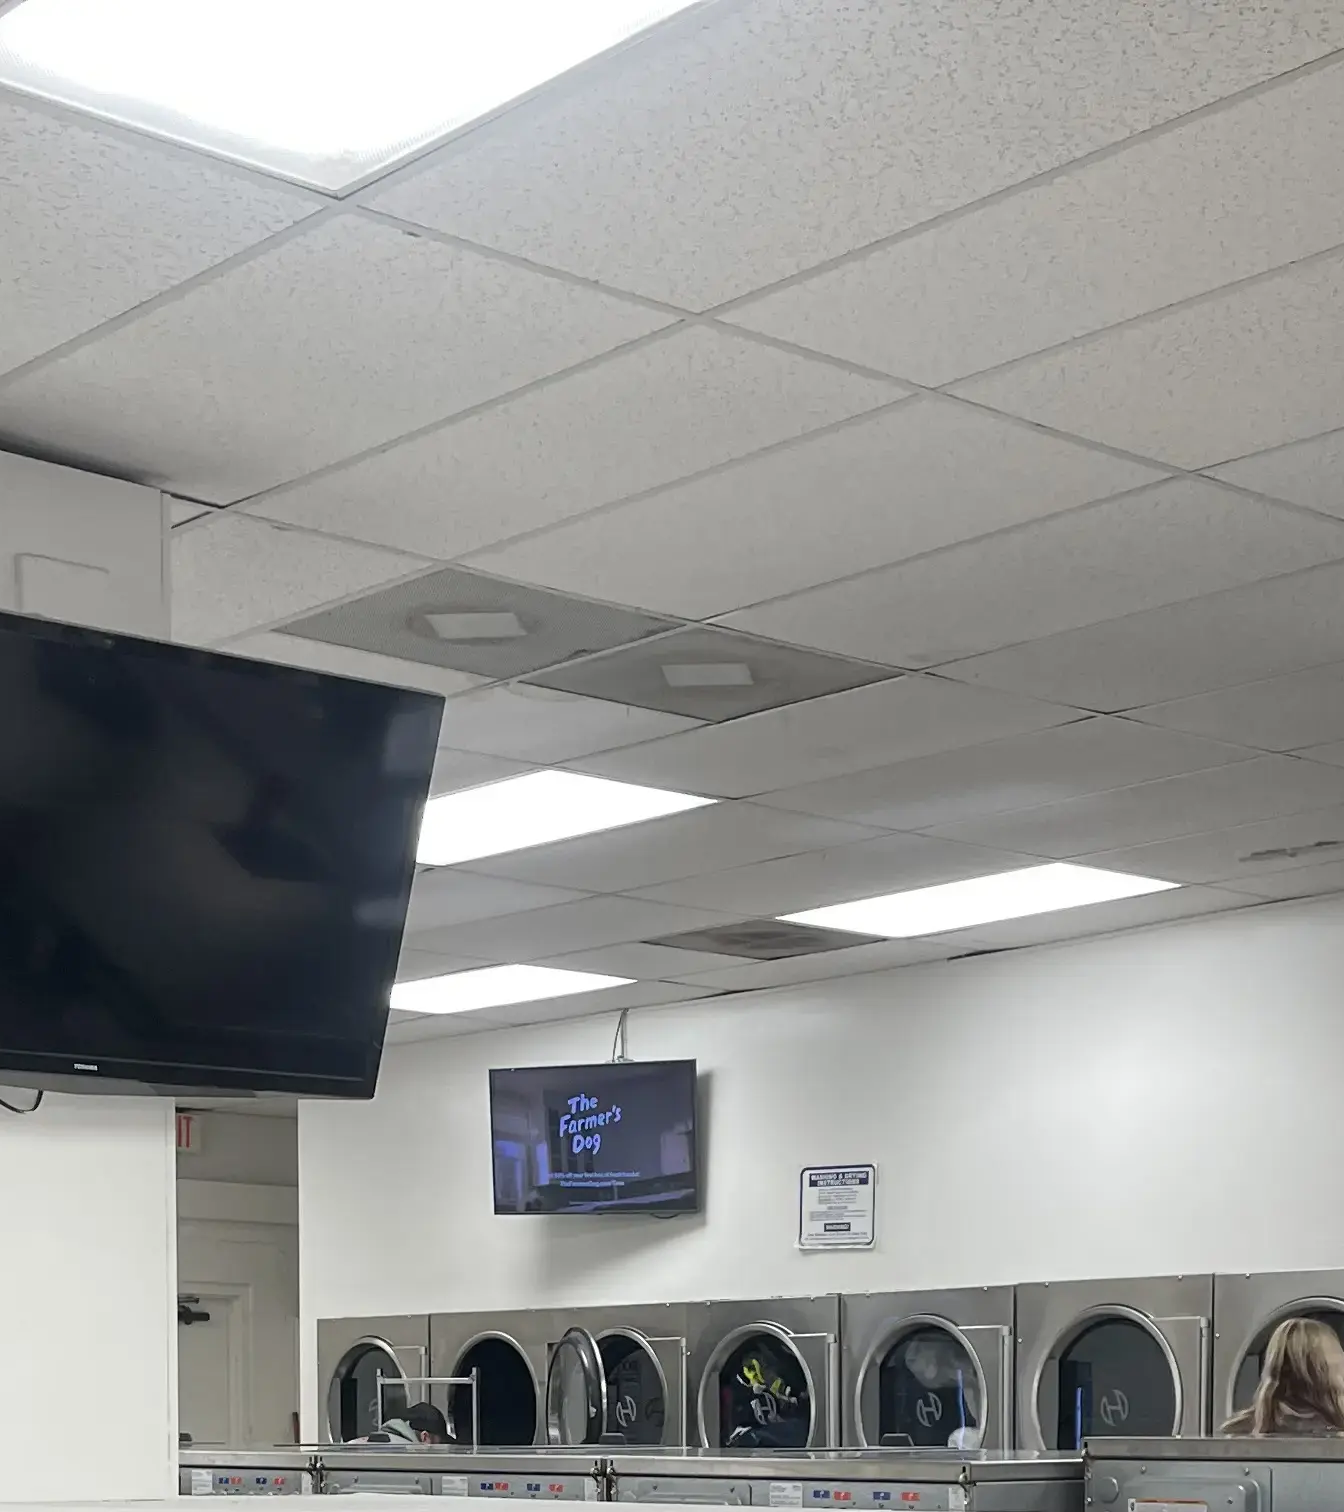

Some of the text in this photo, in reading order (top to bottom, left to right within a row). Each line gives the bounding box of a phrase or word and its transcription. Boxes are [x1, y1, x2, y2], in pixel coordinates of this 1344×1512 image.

[568, 1094, 598, 1114] The
[559, 1104, 622, 1137] Farmer's
[572, 1133, 601, 1154] Dog
